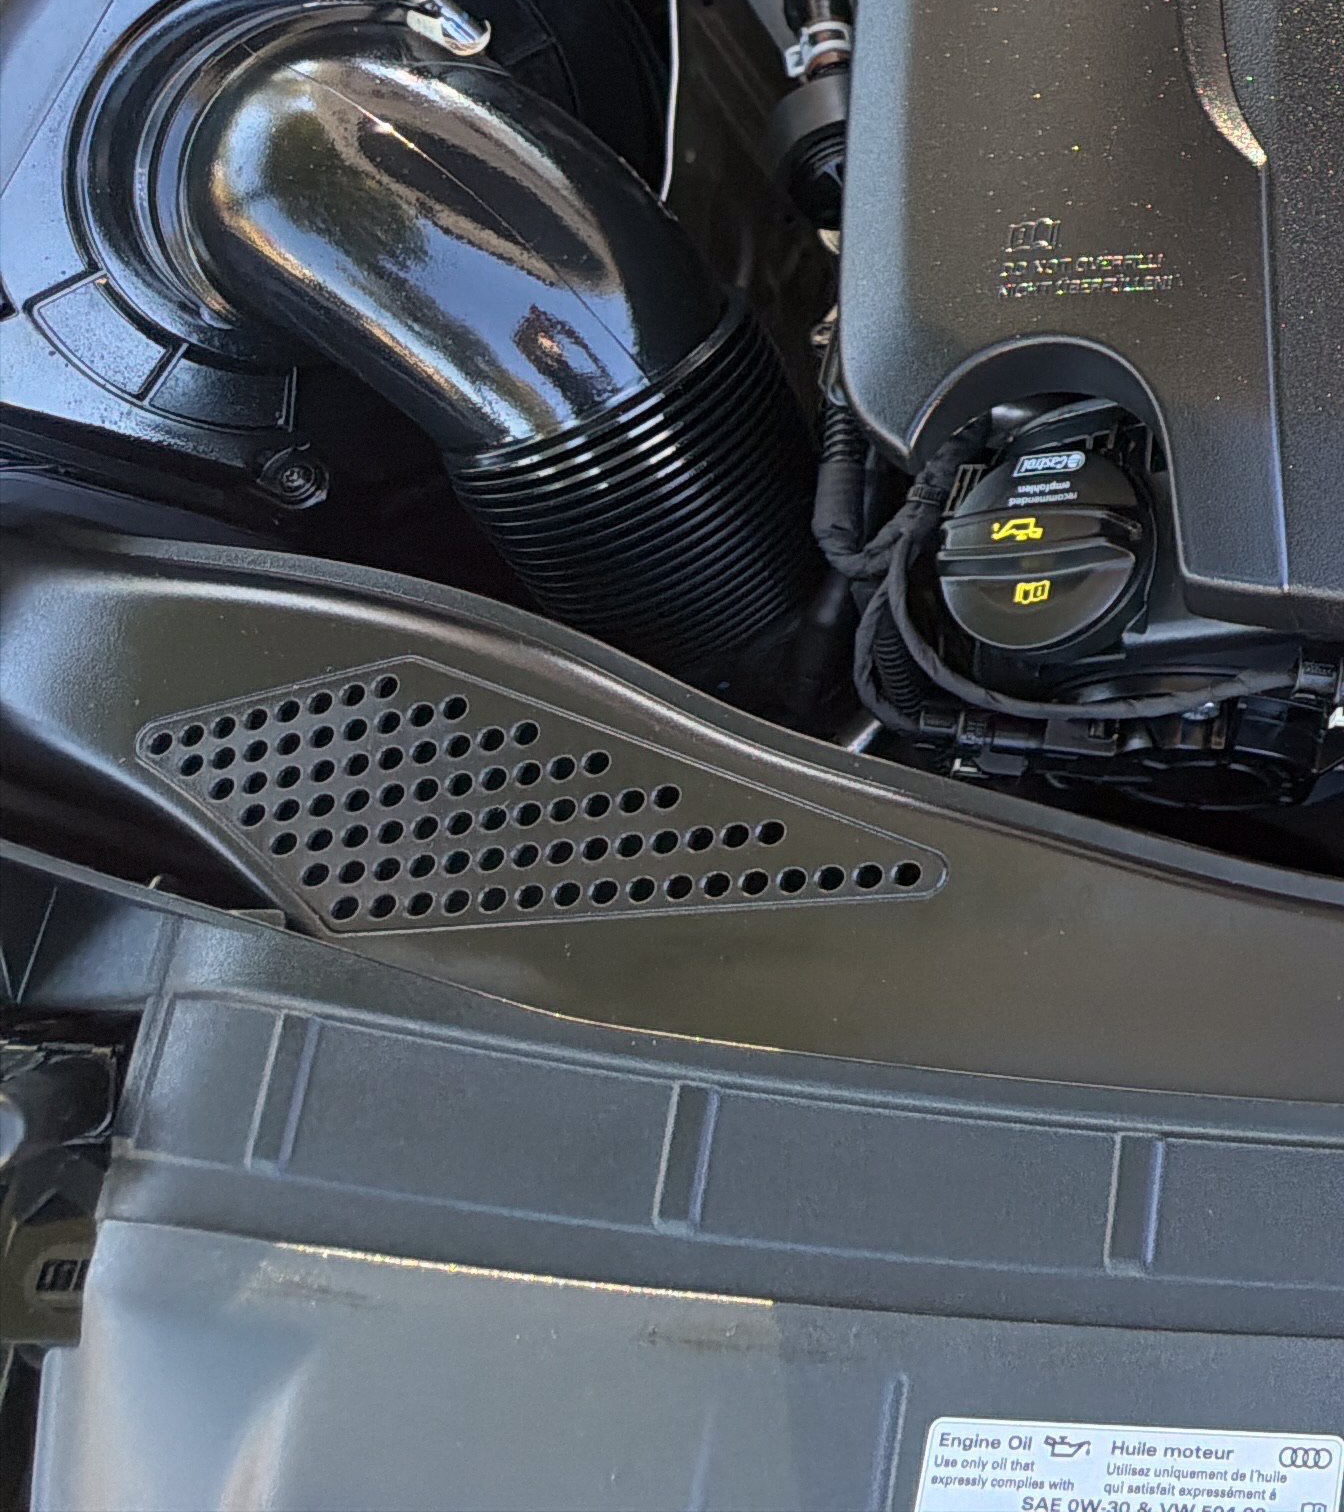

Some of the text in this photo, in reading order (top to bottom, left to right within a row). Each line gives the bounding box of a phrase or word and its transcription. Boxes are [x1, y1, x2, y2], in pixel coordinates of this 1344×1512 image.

[1019, 455, 1069, 473] Castrol
[1007, 491, 1078, 507] recommended
[939, 1432, 1033, 1452] Engine Oil
[1110, 1440, 1235, 1461] Huile moteur
[934, 1454, 1035, 1472] Use only oil that
[1106, 1462, 1151, 1478] Utilisez
[1153, 1465, 1229, 1481] uniquement
[1231, 1469, 1247, 1482] de
[931, 1474, 1075, 1492] expressly complies with
[1103, 1480, 1125, 1495] qui
[1126, 1482, 1176, 1497] satisfait
[1178, 1484, 1267, 1500] expressément
[1021, 1495, 1062, 1512] SAE
